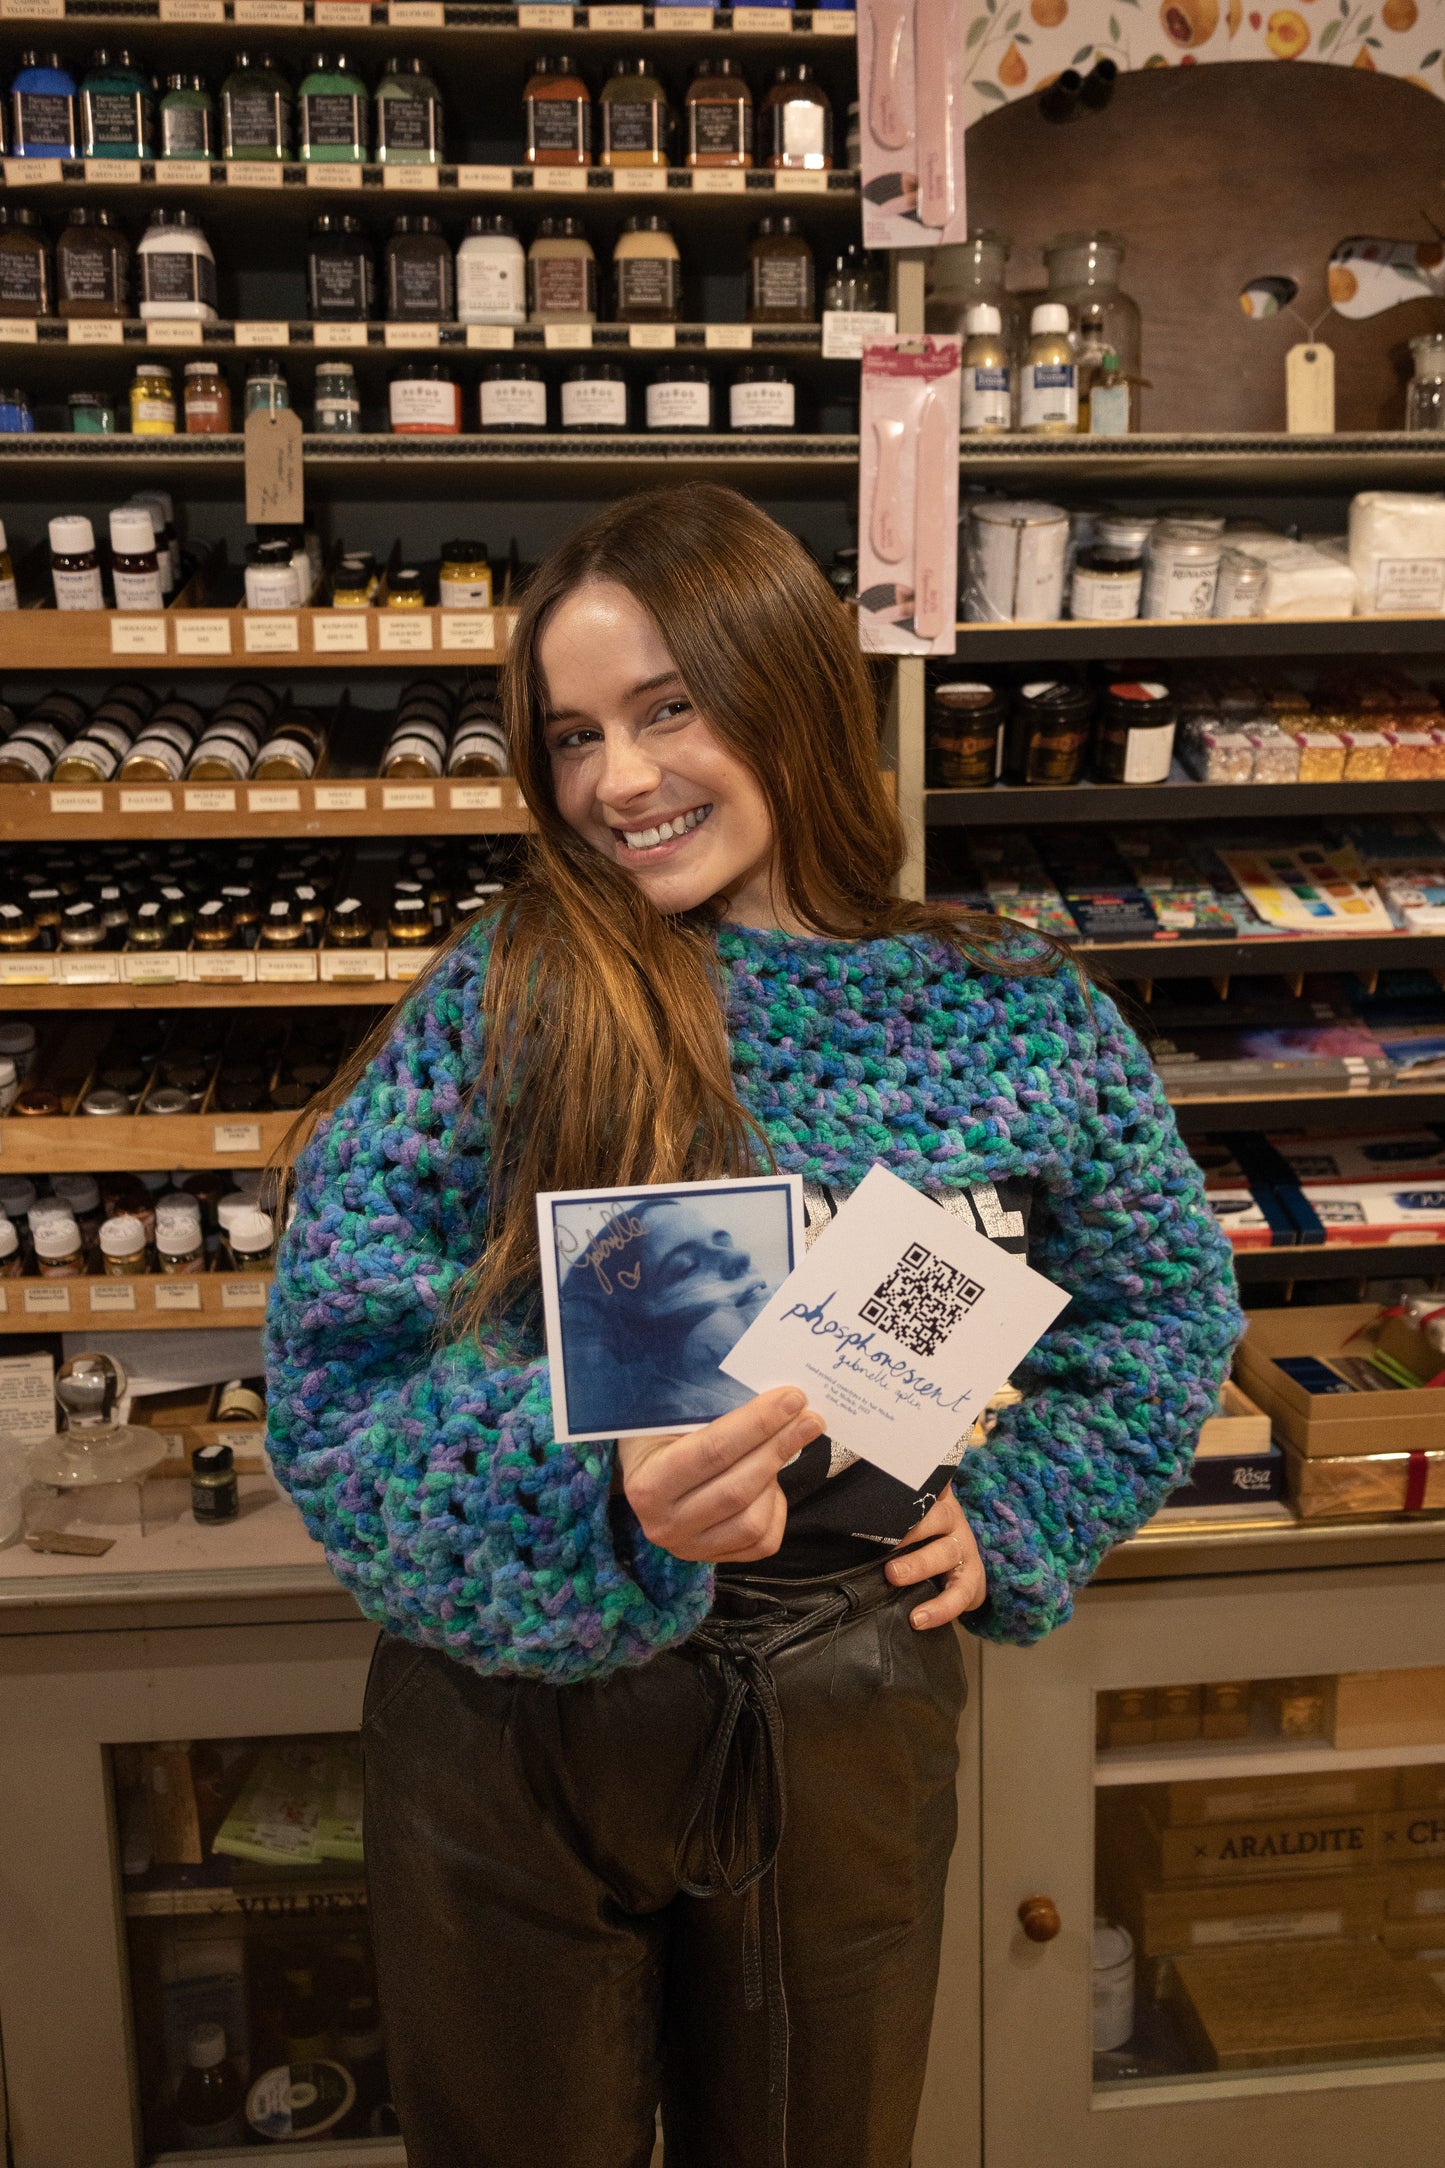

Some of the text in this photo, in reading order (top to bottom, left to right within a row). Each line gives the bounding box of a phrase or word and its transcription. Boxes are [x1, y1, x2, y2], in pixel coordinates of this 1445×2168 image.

[780, 1290, 972, 1412] phosphorescent
[1218, 1826, 1365, 1860] ARALDITE
[238, 1892, 368, 1920] VULPEX
